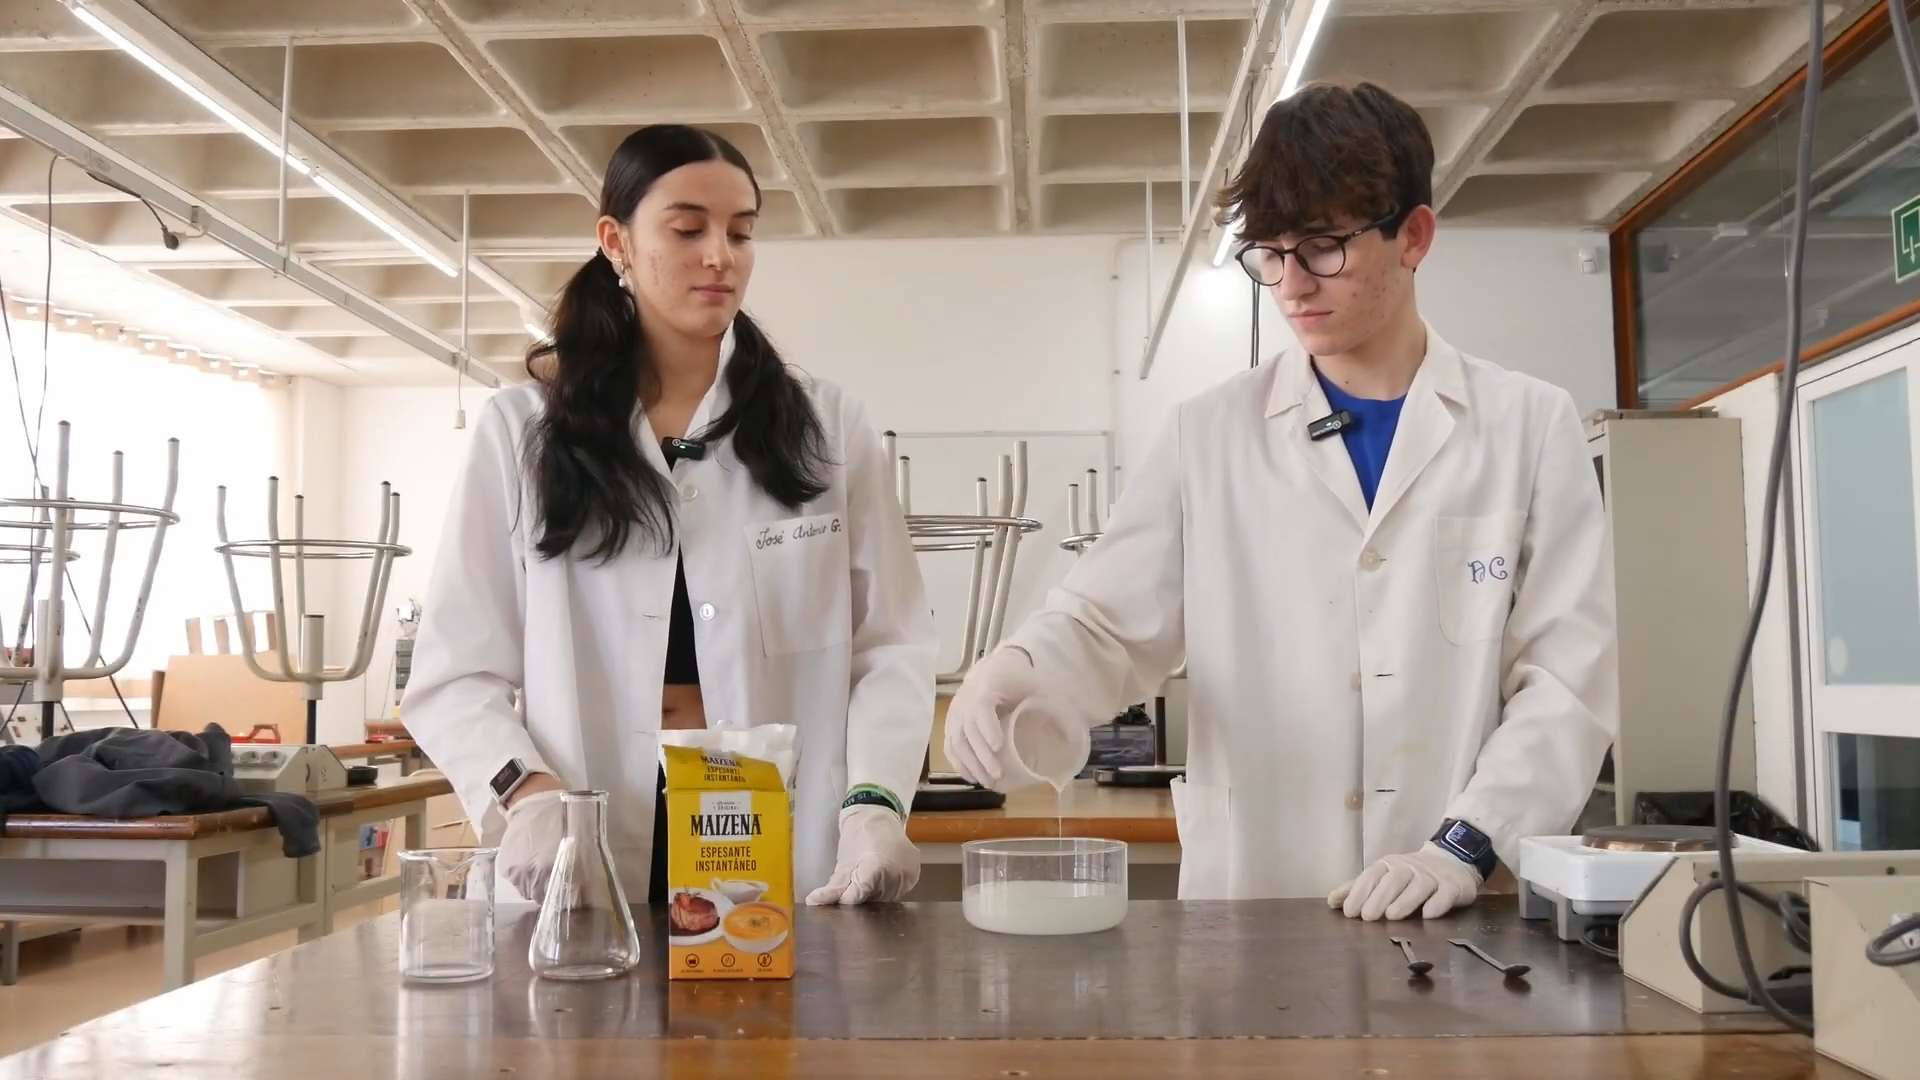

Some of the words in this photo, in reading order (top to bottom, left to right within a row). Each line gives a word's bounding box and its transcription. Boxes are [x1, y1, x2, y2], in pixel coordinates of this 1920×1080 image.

[756, 527, 784, 550] José
[690, 813, 762, 837] MAIZENA
[700, 846, 751, 858] ESPESANTE
[696, 857, 757, 872] INSTANTÁNEO
